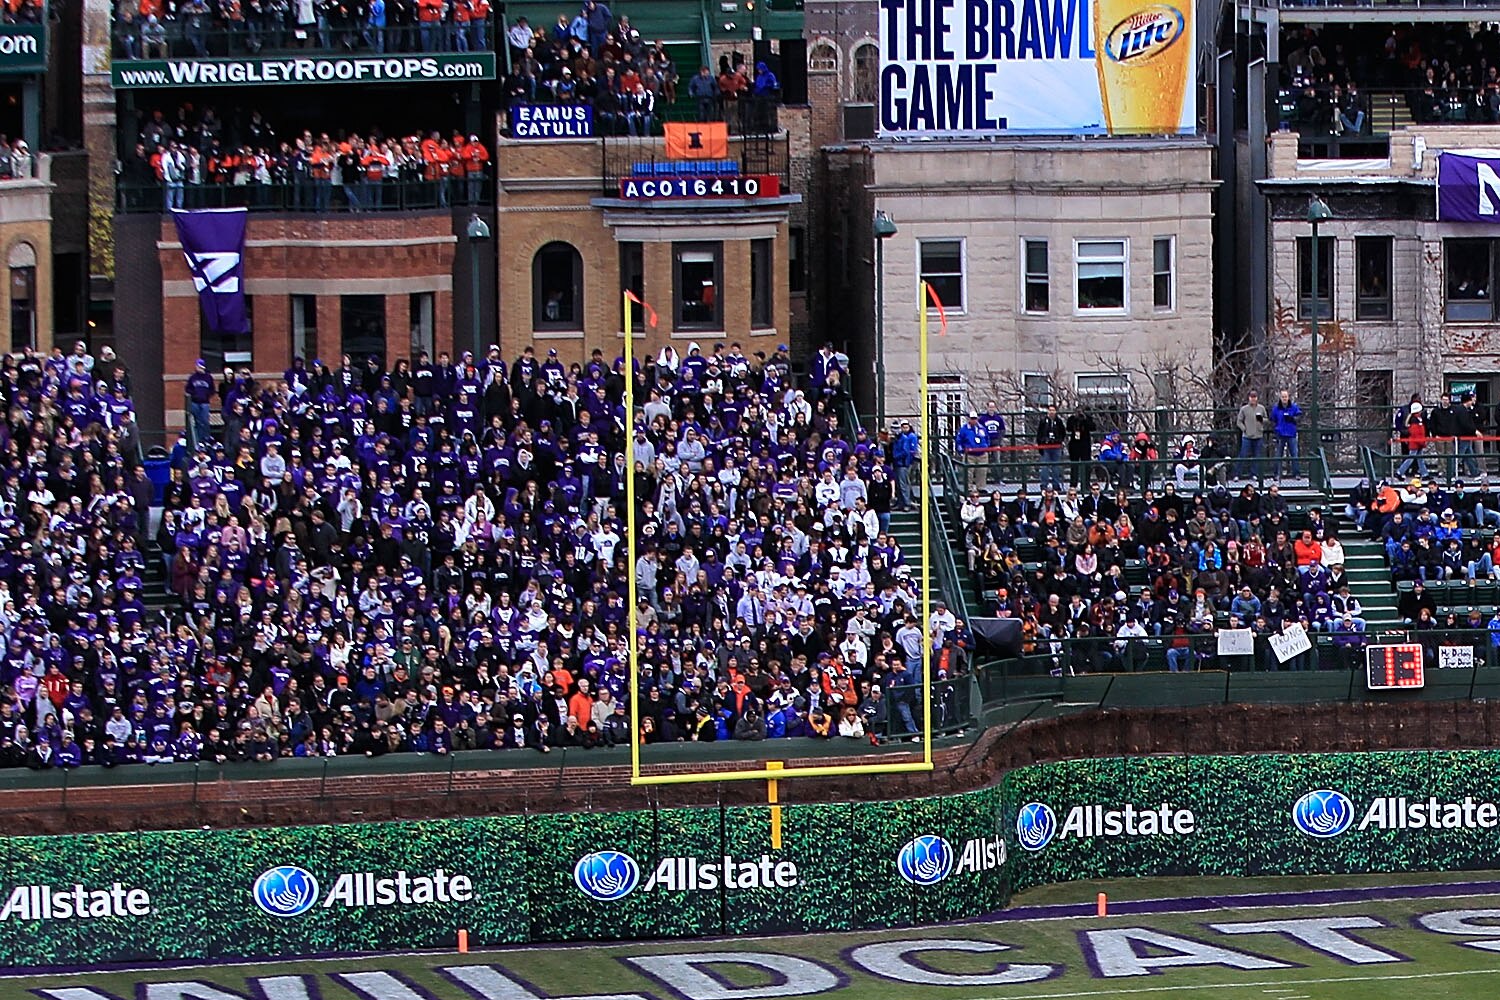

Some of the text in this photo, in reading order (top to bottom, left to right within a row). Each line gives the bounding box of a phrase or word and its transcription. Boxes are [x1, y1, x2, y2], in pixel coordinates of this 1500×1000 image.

[880, 0, 1096, 61] THE BRAWL
[1117, 18, 1174, 61] Lite
[1127, 12, 1164, 30] Miller
[519, 106, 587, 121] EAMUS
[881, 63, 1008, 130] GAME.
[1384, 645, 1422, 687] 13
[1060, 803, 1195, 840] Allstate
[1358, 796, 1499, 831] Allstate
[322, 867, 474, 908] Allstate
[643, 854, 798, 892] Allstate
[0, 883, 151, 920] Allstate
